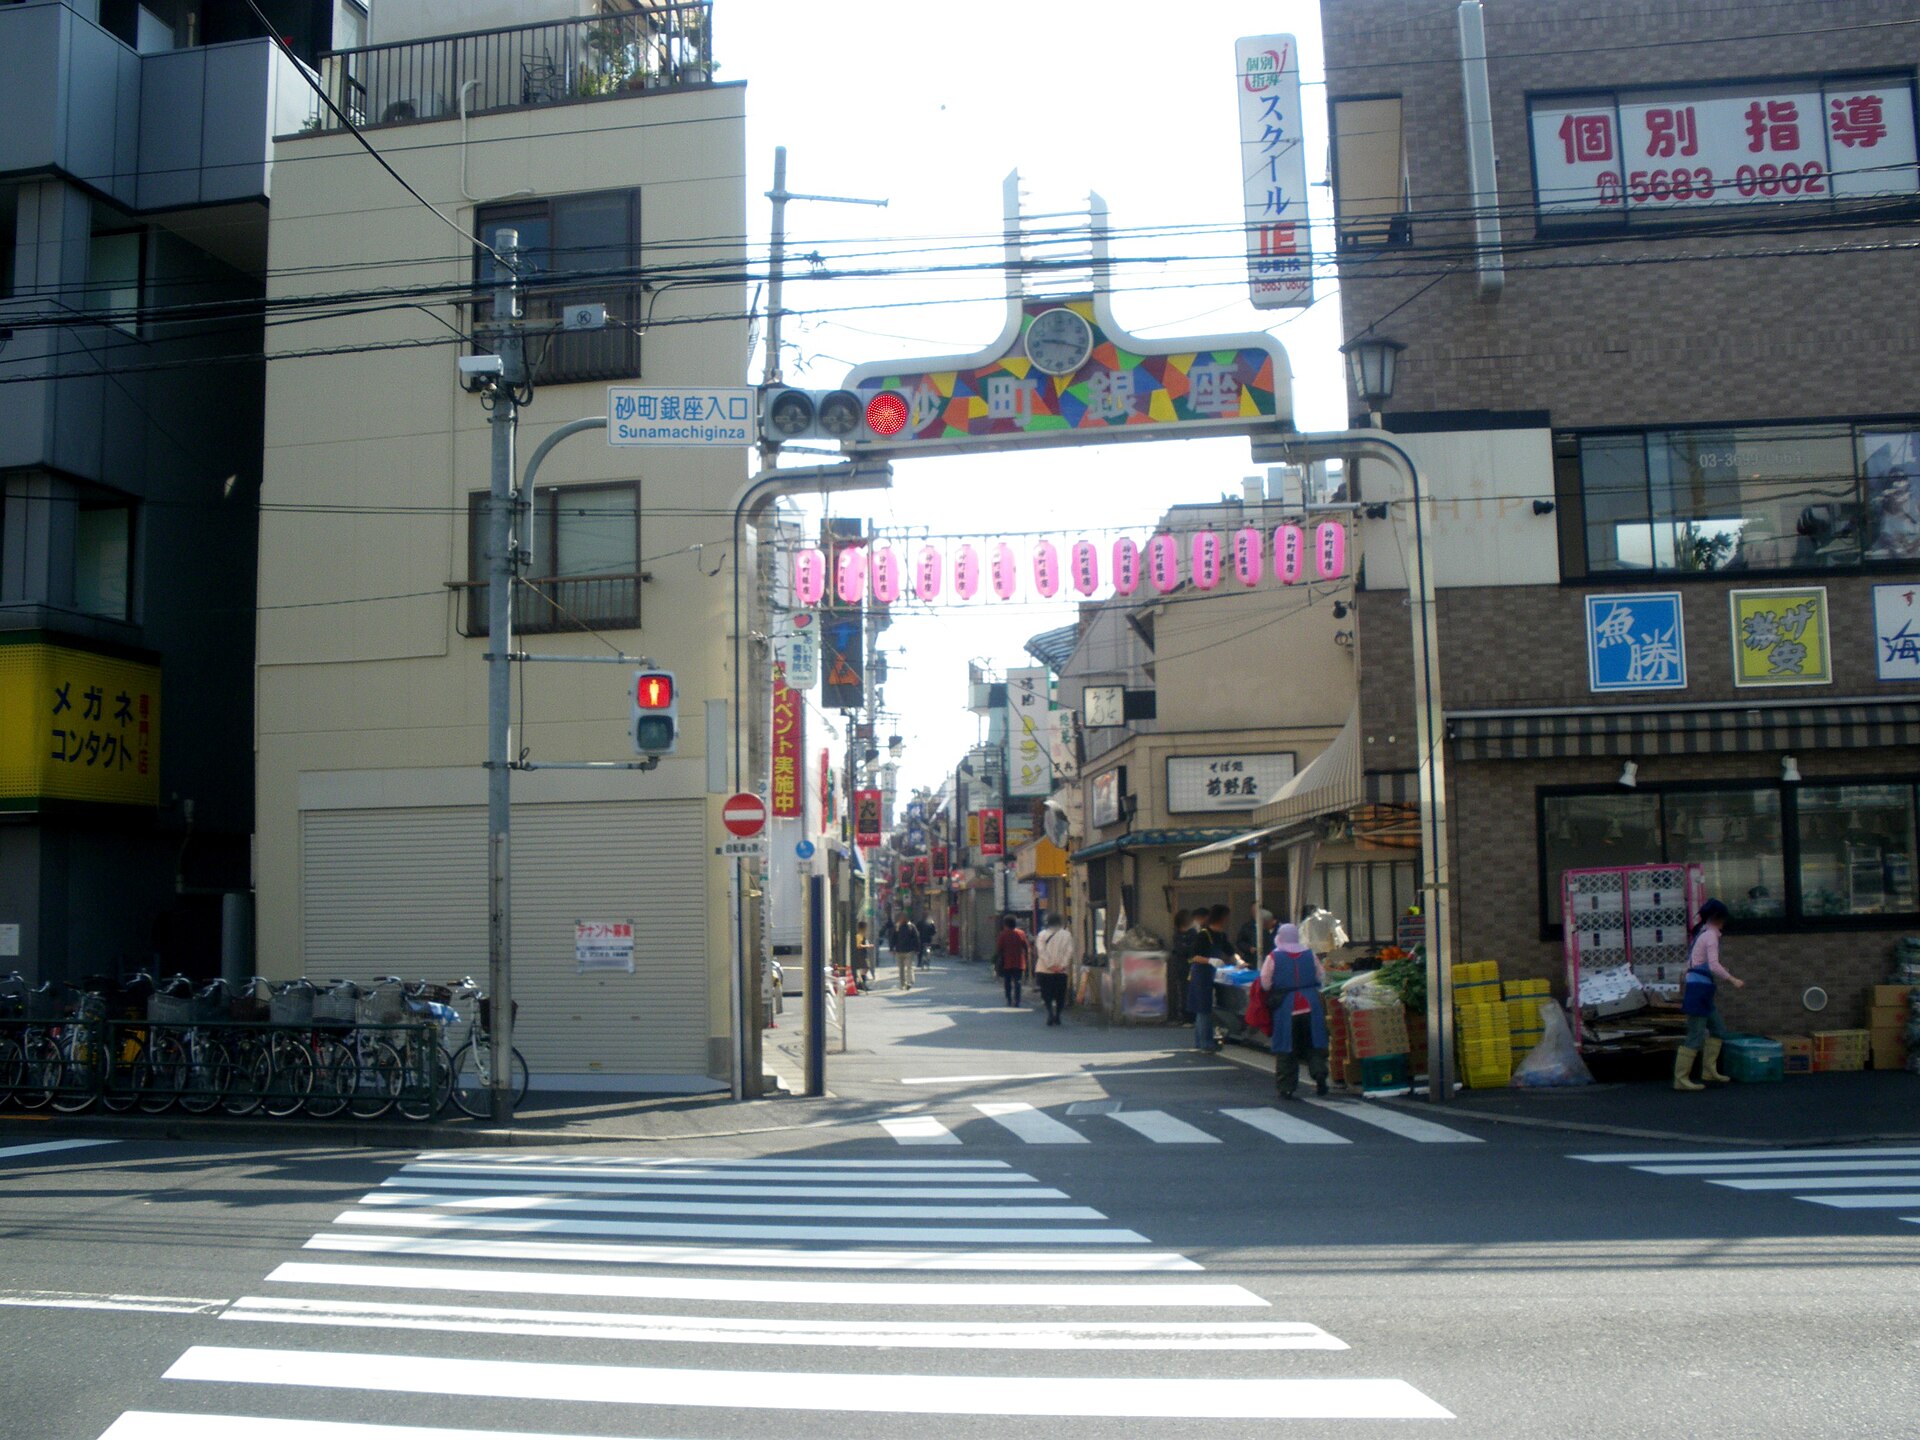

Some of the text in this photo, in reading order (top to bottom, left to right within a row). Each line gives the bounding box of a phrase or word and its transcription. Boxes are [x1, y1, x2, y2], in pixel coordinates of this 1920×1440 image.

[1558, 94, 1887, 165] 個別指導
[1258, 94, 1290, 216] スクール
[1629, 160, 1825, 203] 5683-0802
[615, 395, 748, 421] 砂町銀座入口
[618, 424, 745, 442] Sunamachiginza
[1287, 533, 1297, 574] 砂町銀座
[1324, 529, 1334, 571] 砂町銀座
[52, 681, 134, 728] メガネ
[51, 729, 133, 772] コンタクト
